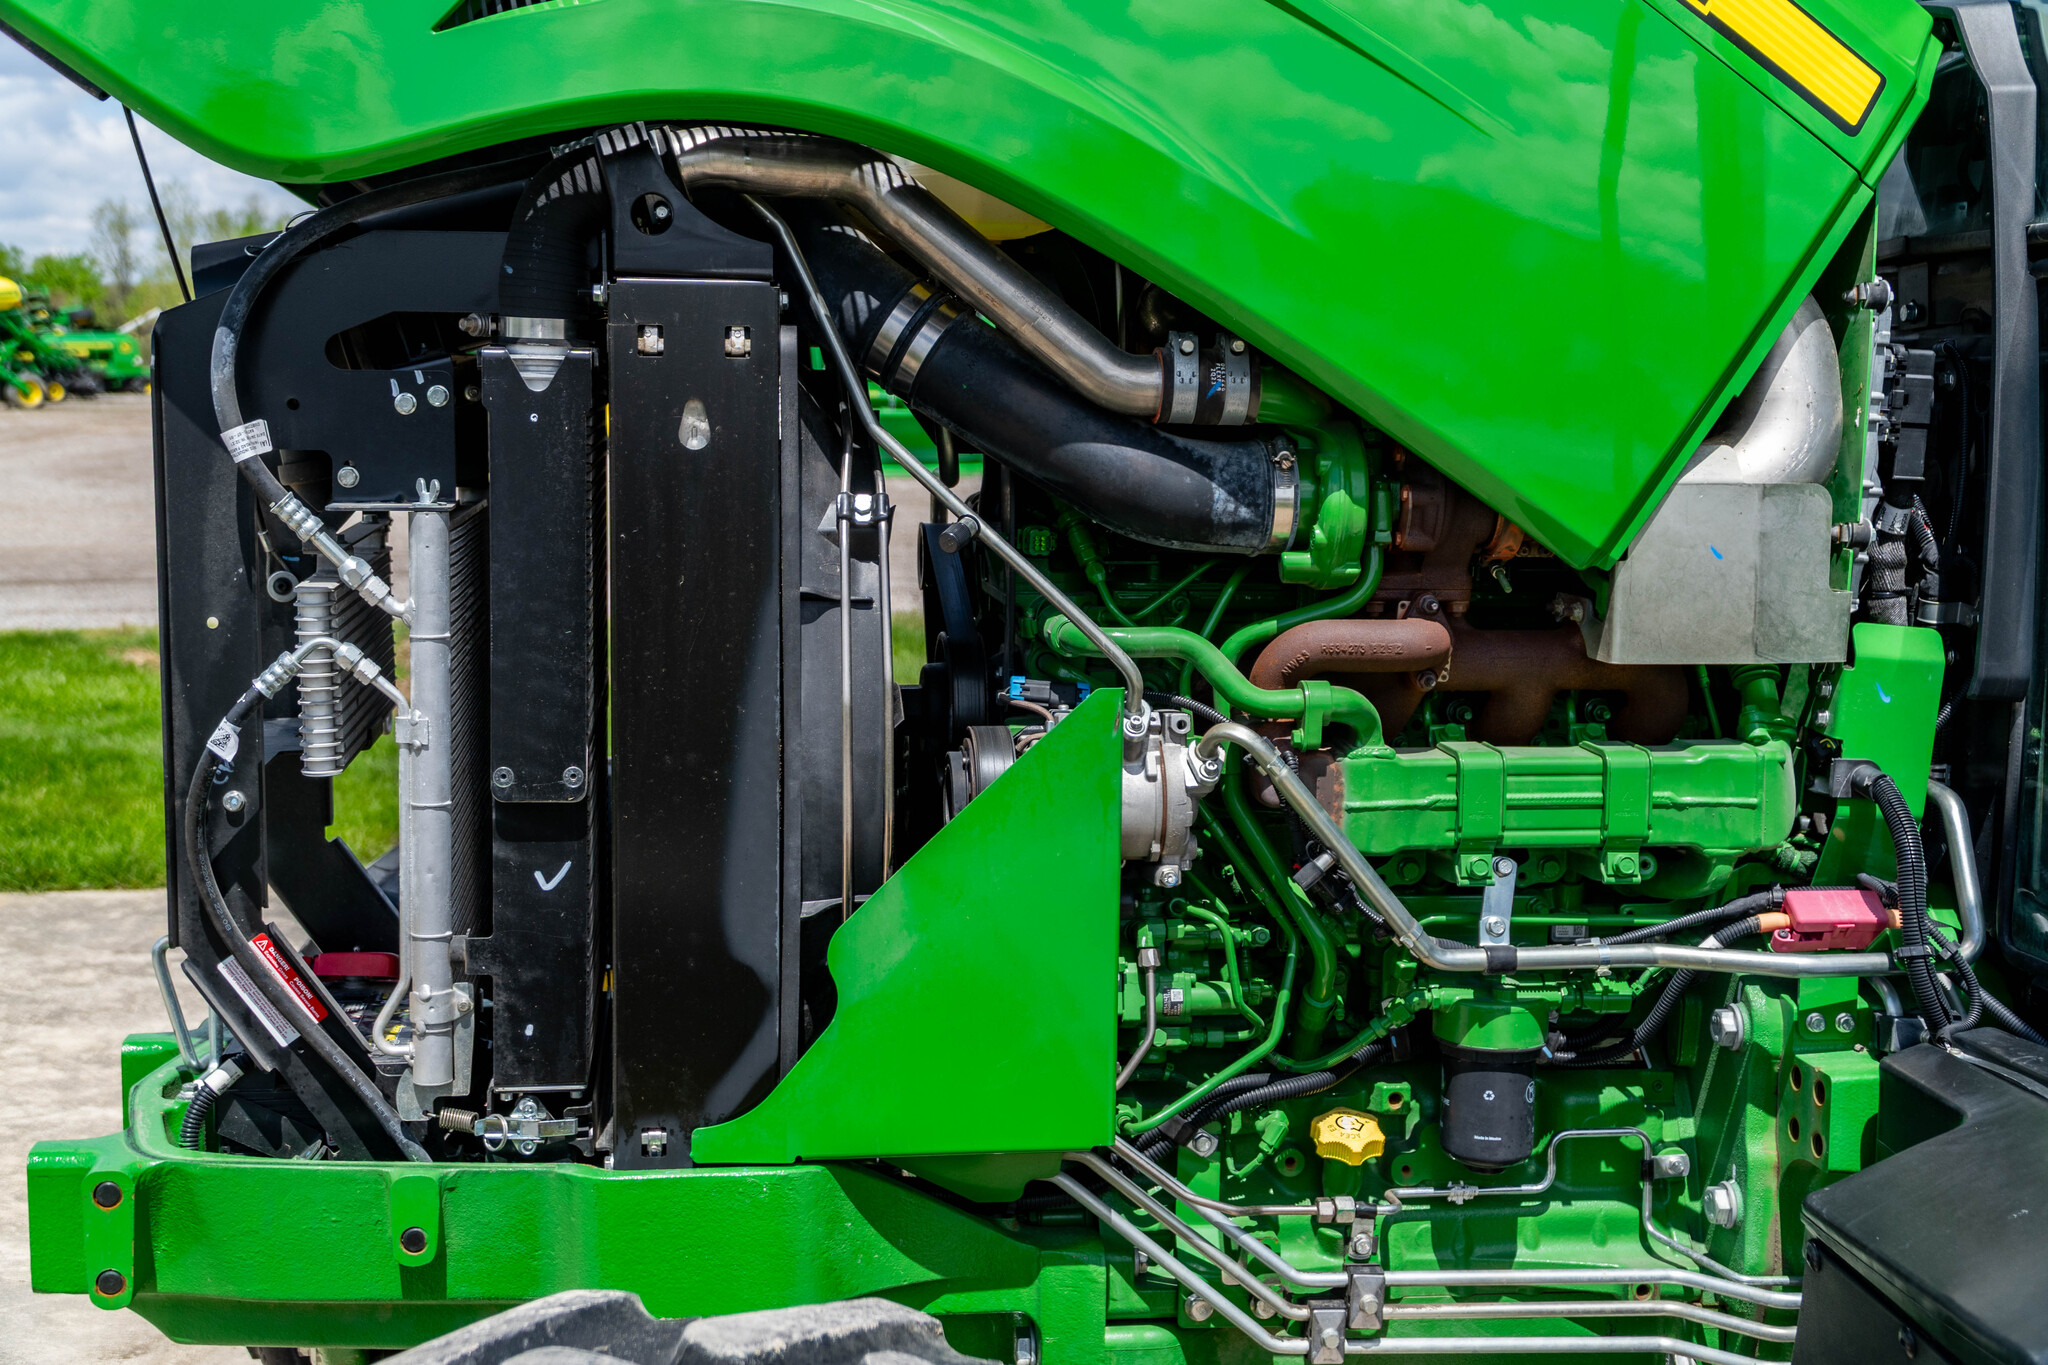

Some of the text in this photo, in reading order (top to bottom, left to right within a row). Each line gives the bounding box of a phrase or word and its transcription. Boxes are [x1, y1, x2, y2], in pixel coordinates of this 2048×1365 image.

[268, 945, 290, 971] DANGER!
[288, 980, 320, 1018] Causes Severe Burns
[292, 976, 313, 999] POISON!
